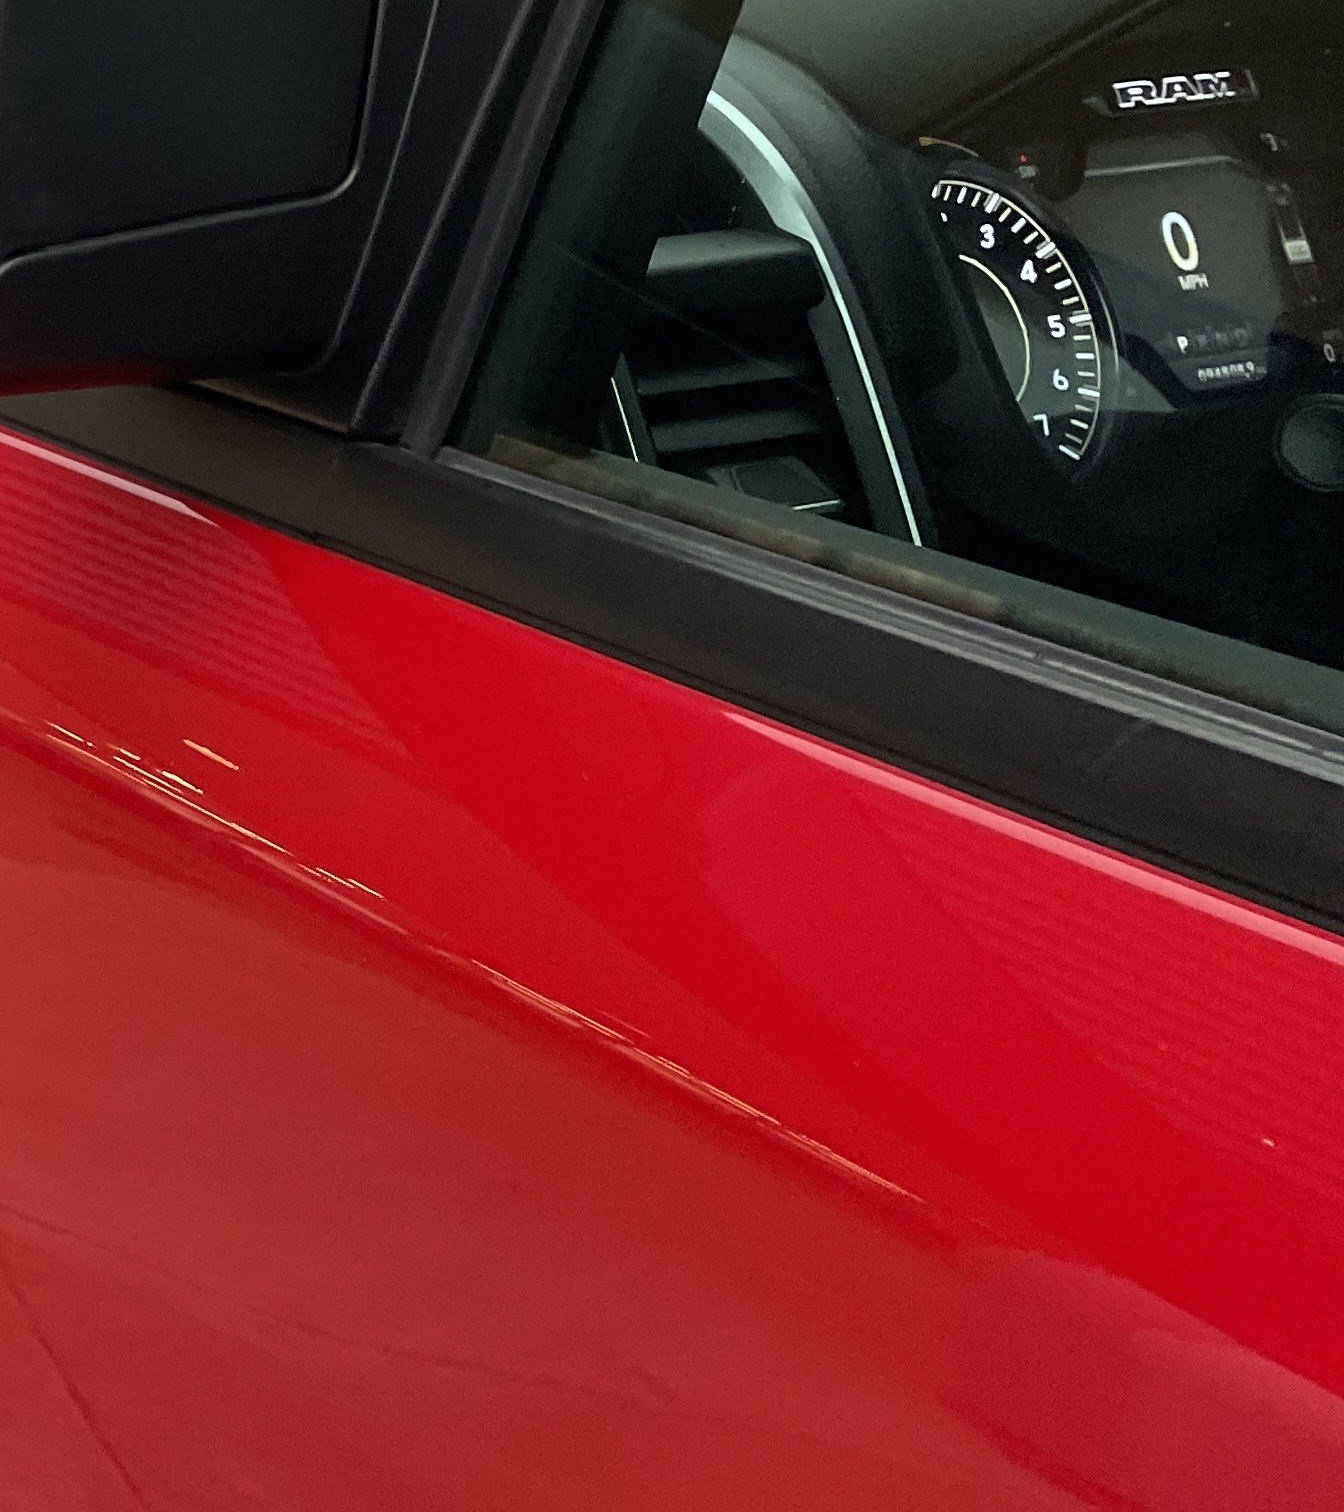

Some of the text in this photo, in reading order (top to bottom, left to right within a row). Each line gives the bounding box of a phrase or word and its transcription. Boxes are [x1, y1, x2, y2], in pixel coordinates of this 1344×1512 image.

[1112, 70, 1237, 108] RAM
[979, 223, 996, 249] 3
[1161, 211, 1199, 271] 0
[1020, 259, 1038, 284] 4
[1047, 314, 1066, 338] 5
[1052, 368, 1069, 391] 6
[1033, 413, 1050, 437] 7
